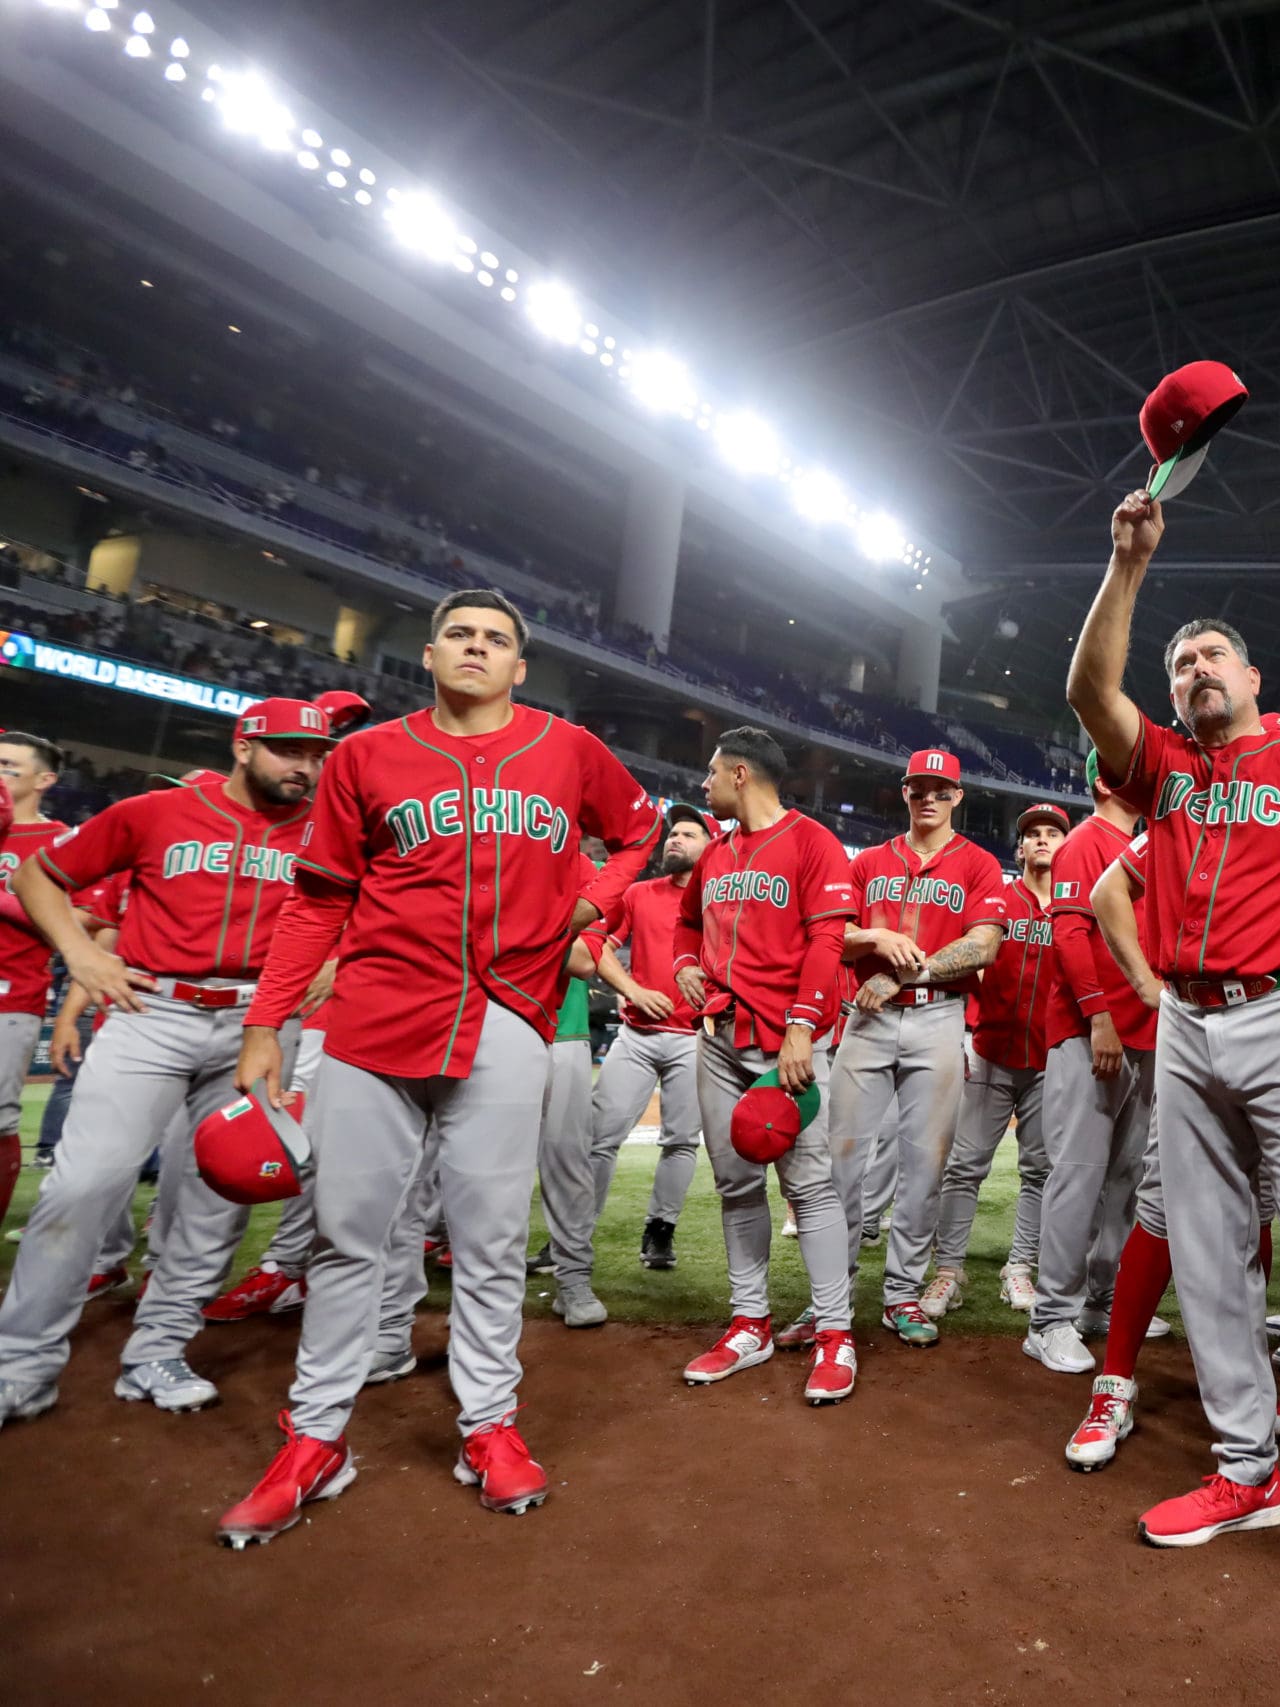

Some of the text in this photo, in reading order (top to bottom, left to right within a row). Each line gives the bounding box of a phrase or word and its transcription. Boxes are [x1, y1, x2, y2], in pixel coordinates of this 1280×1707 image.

[34, 645, 265, 716] WORLD BASEBALL CLA
[385, 787, 569, 858] MEXICO
[702, 870, 790, 909] MEXICO
[866, 876, 965, 914] MEXICO
